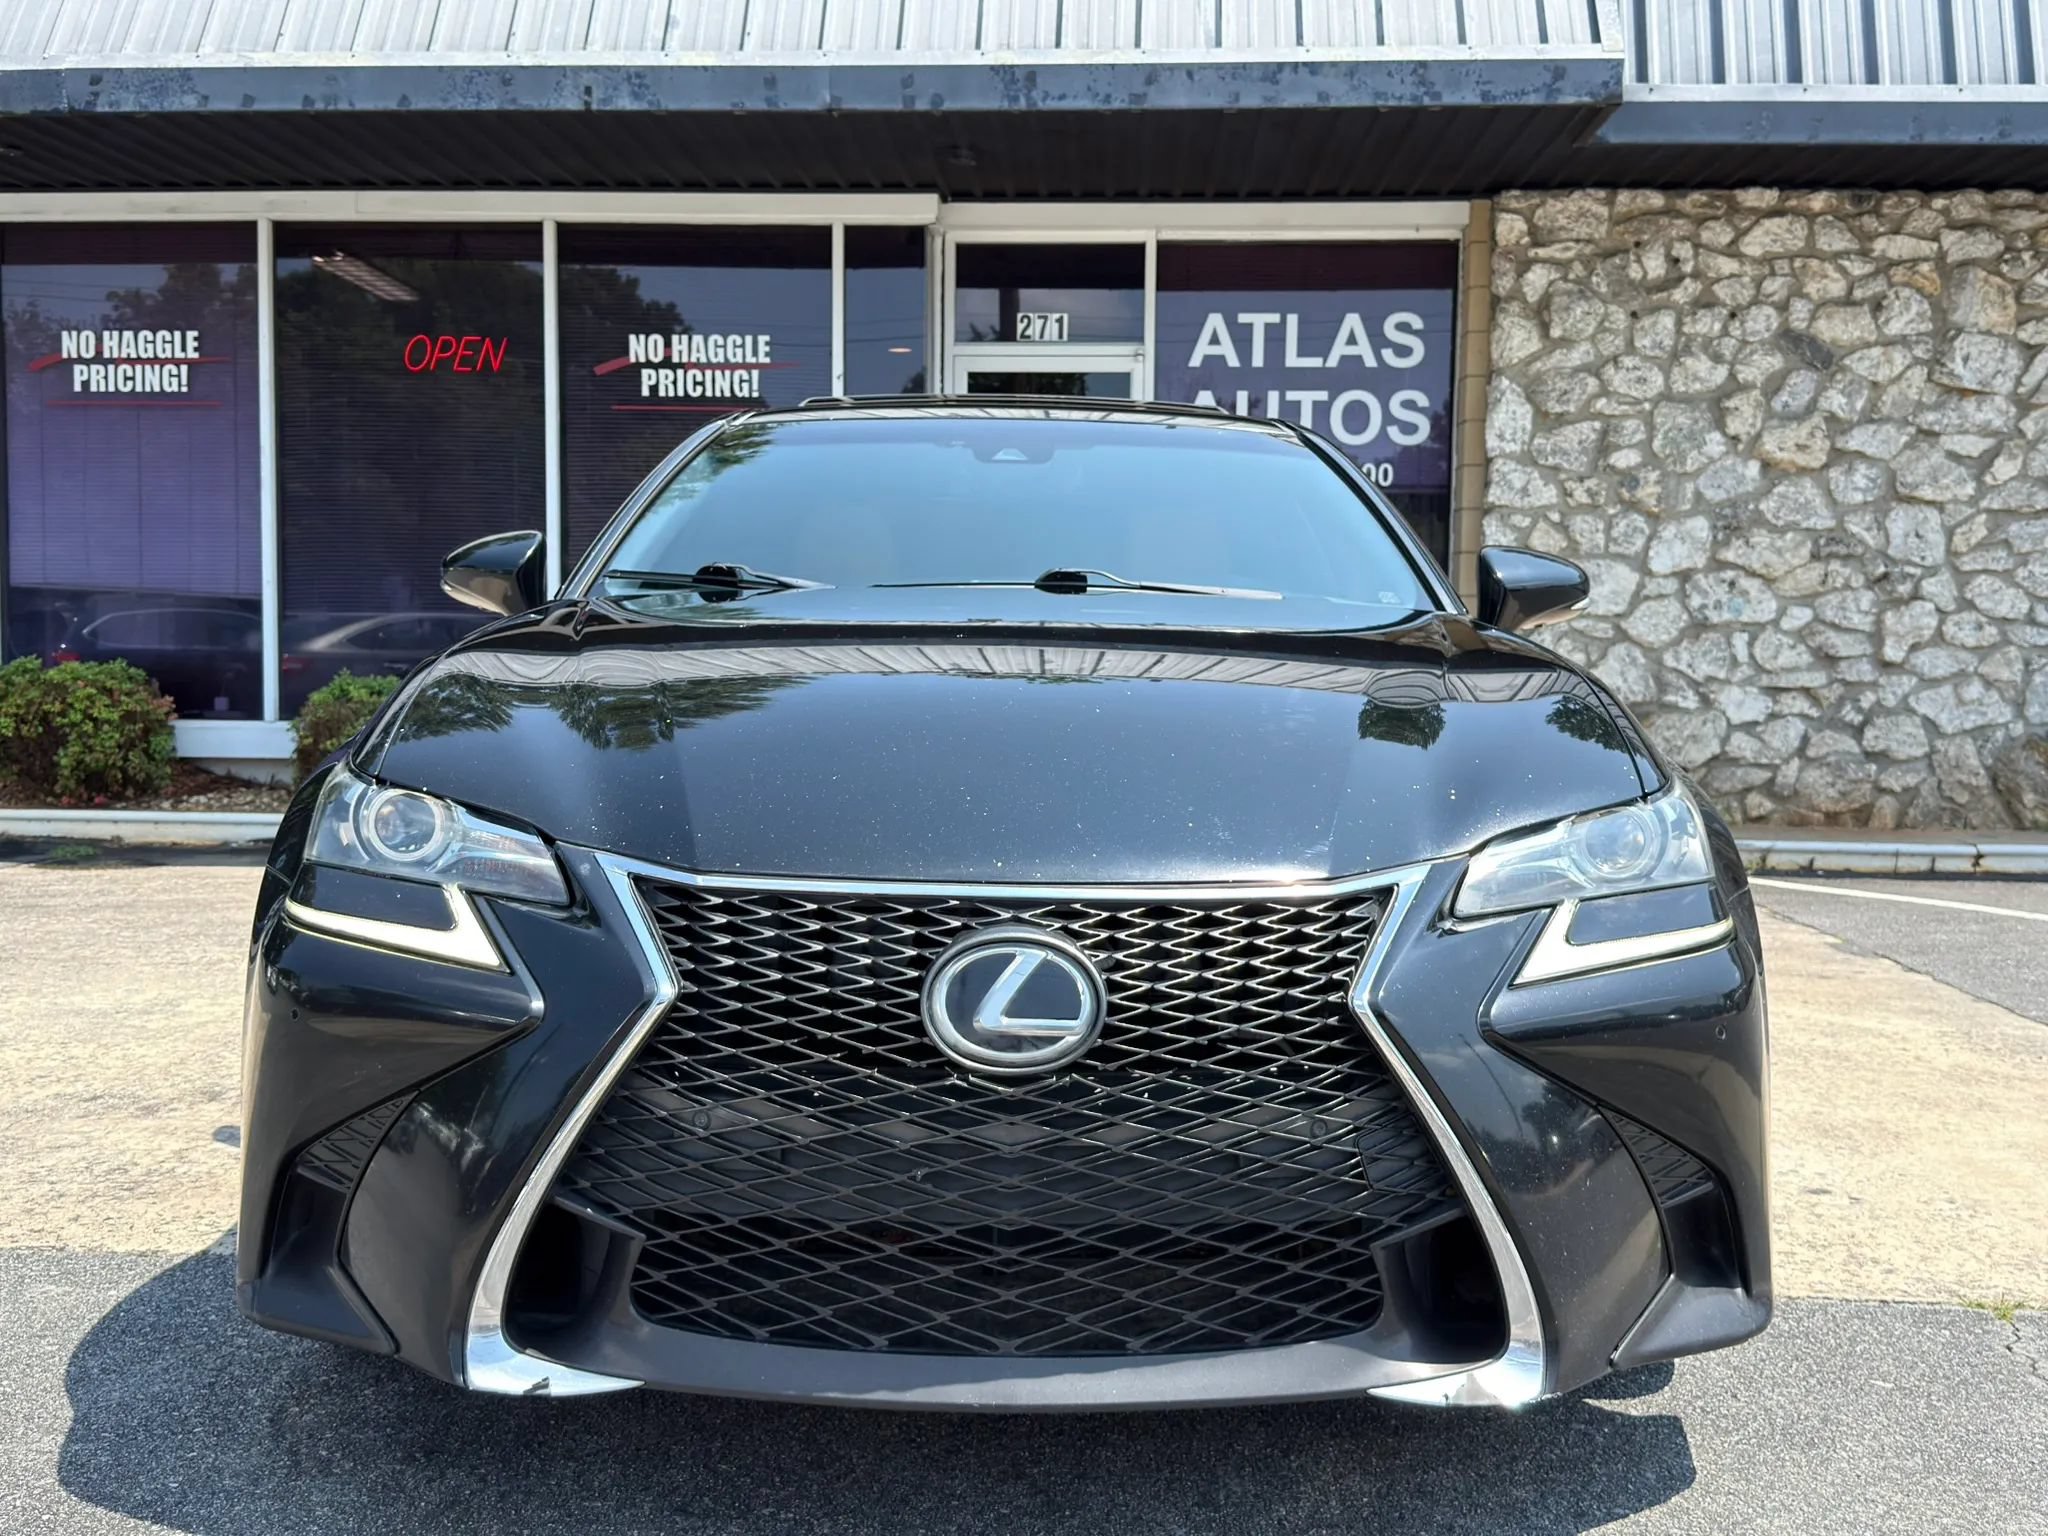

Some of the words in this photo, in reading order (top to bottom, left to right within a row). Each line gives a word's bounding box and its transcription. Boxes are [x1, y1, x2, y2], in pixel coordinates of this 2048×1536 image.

[1019, 314, 1065, 340] 271
[1187, 312, 1426, 368] ATLAS
[61, 330, 96, 359] NO
[102, 330, 200, 359] HAGGLE
[403, 333, 509, 373] OPEN
[628, 333, 665, 363] NO
[671, 334, 771, 363] HAGGLE
[73, 364, 189, 393] PRICING!
[640, 368, 760, 397] PRICING!
[1193, 389, 1431, 446] TOS
